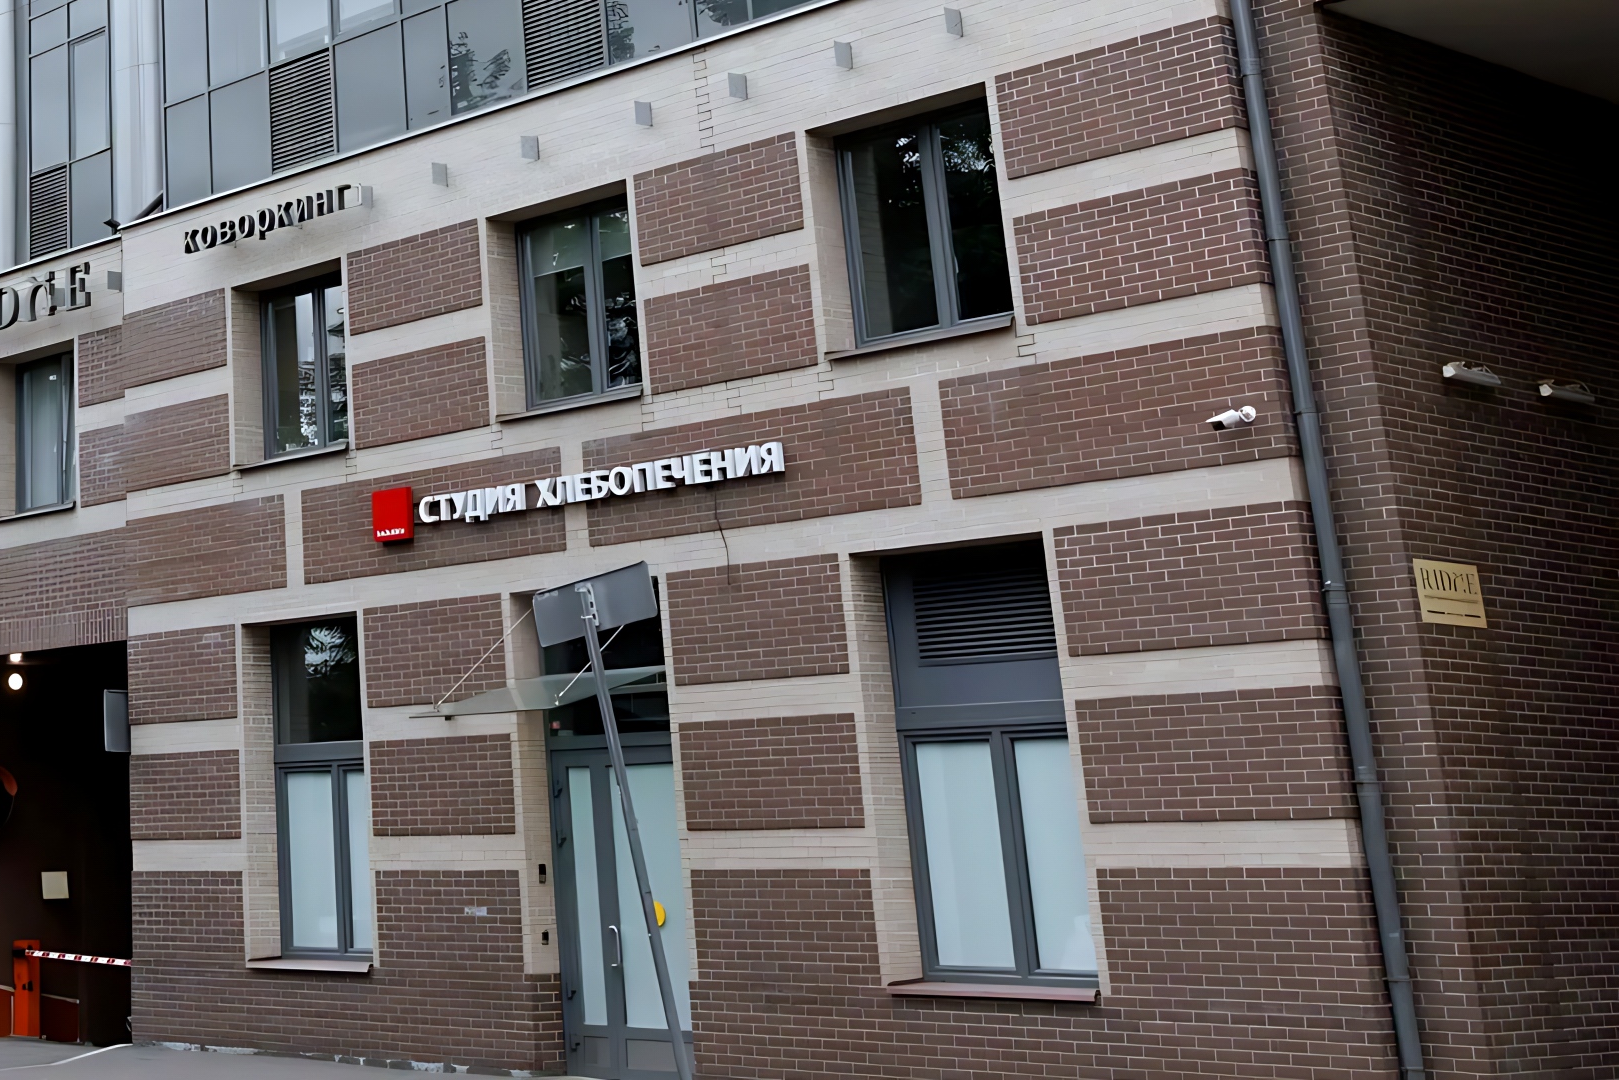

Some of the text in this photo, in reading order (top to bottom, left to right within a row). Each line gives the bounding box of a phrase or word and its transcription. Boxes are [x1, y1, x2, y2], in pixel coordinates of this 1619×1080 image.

[184, 184, 352, 255] коворкинг
[418, 441, 786, 523] СТУДИЯ ХЛЕБОПЕЧЕНИЯ
